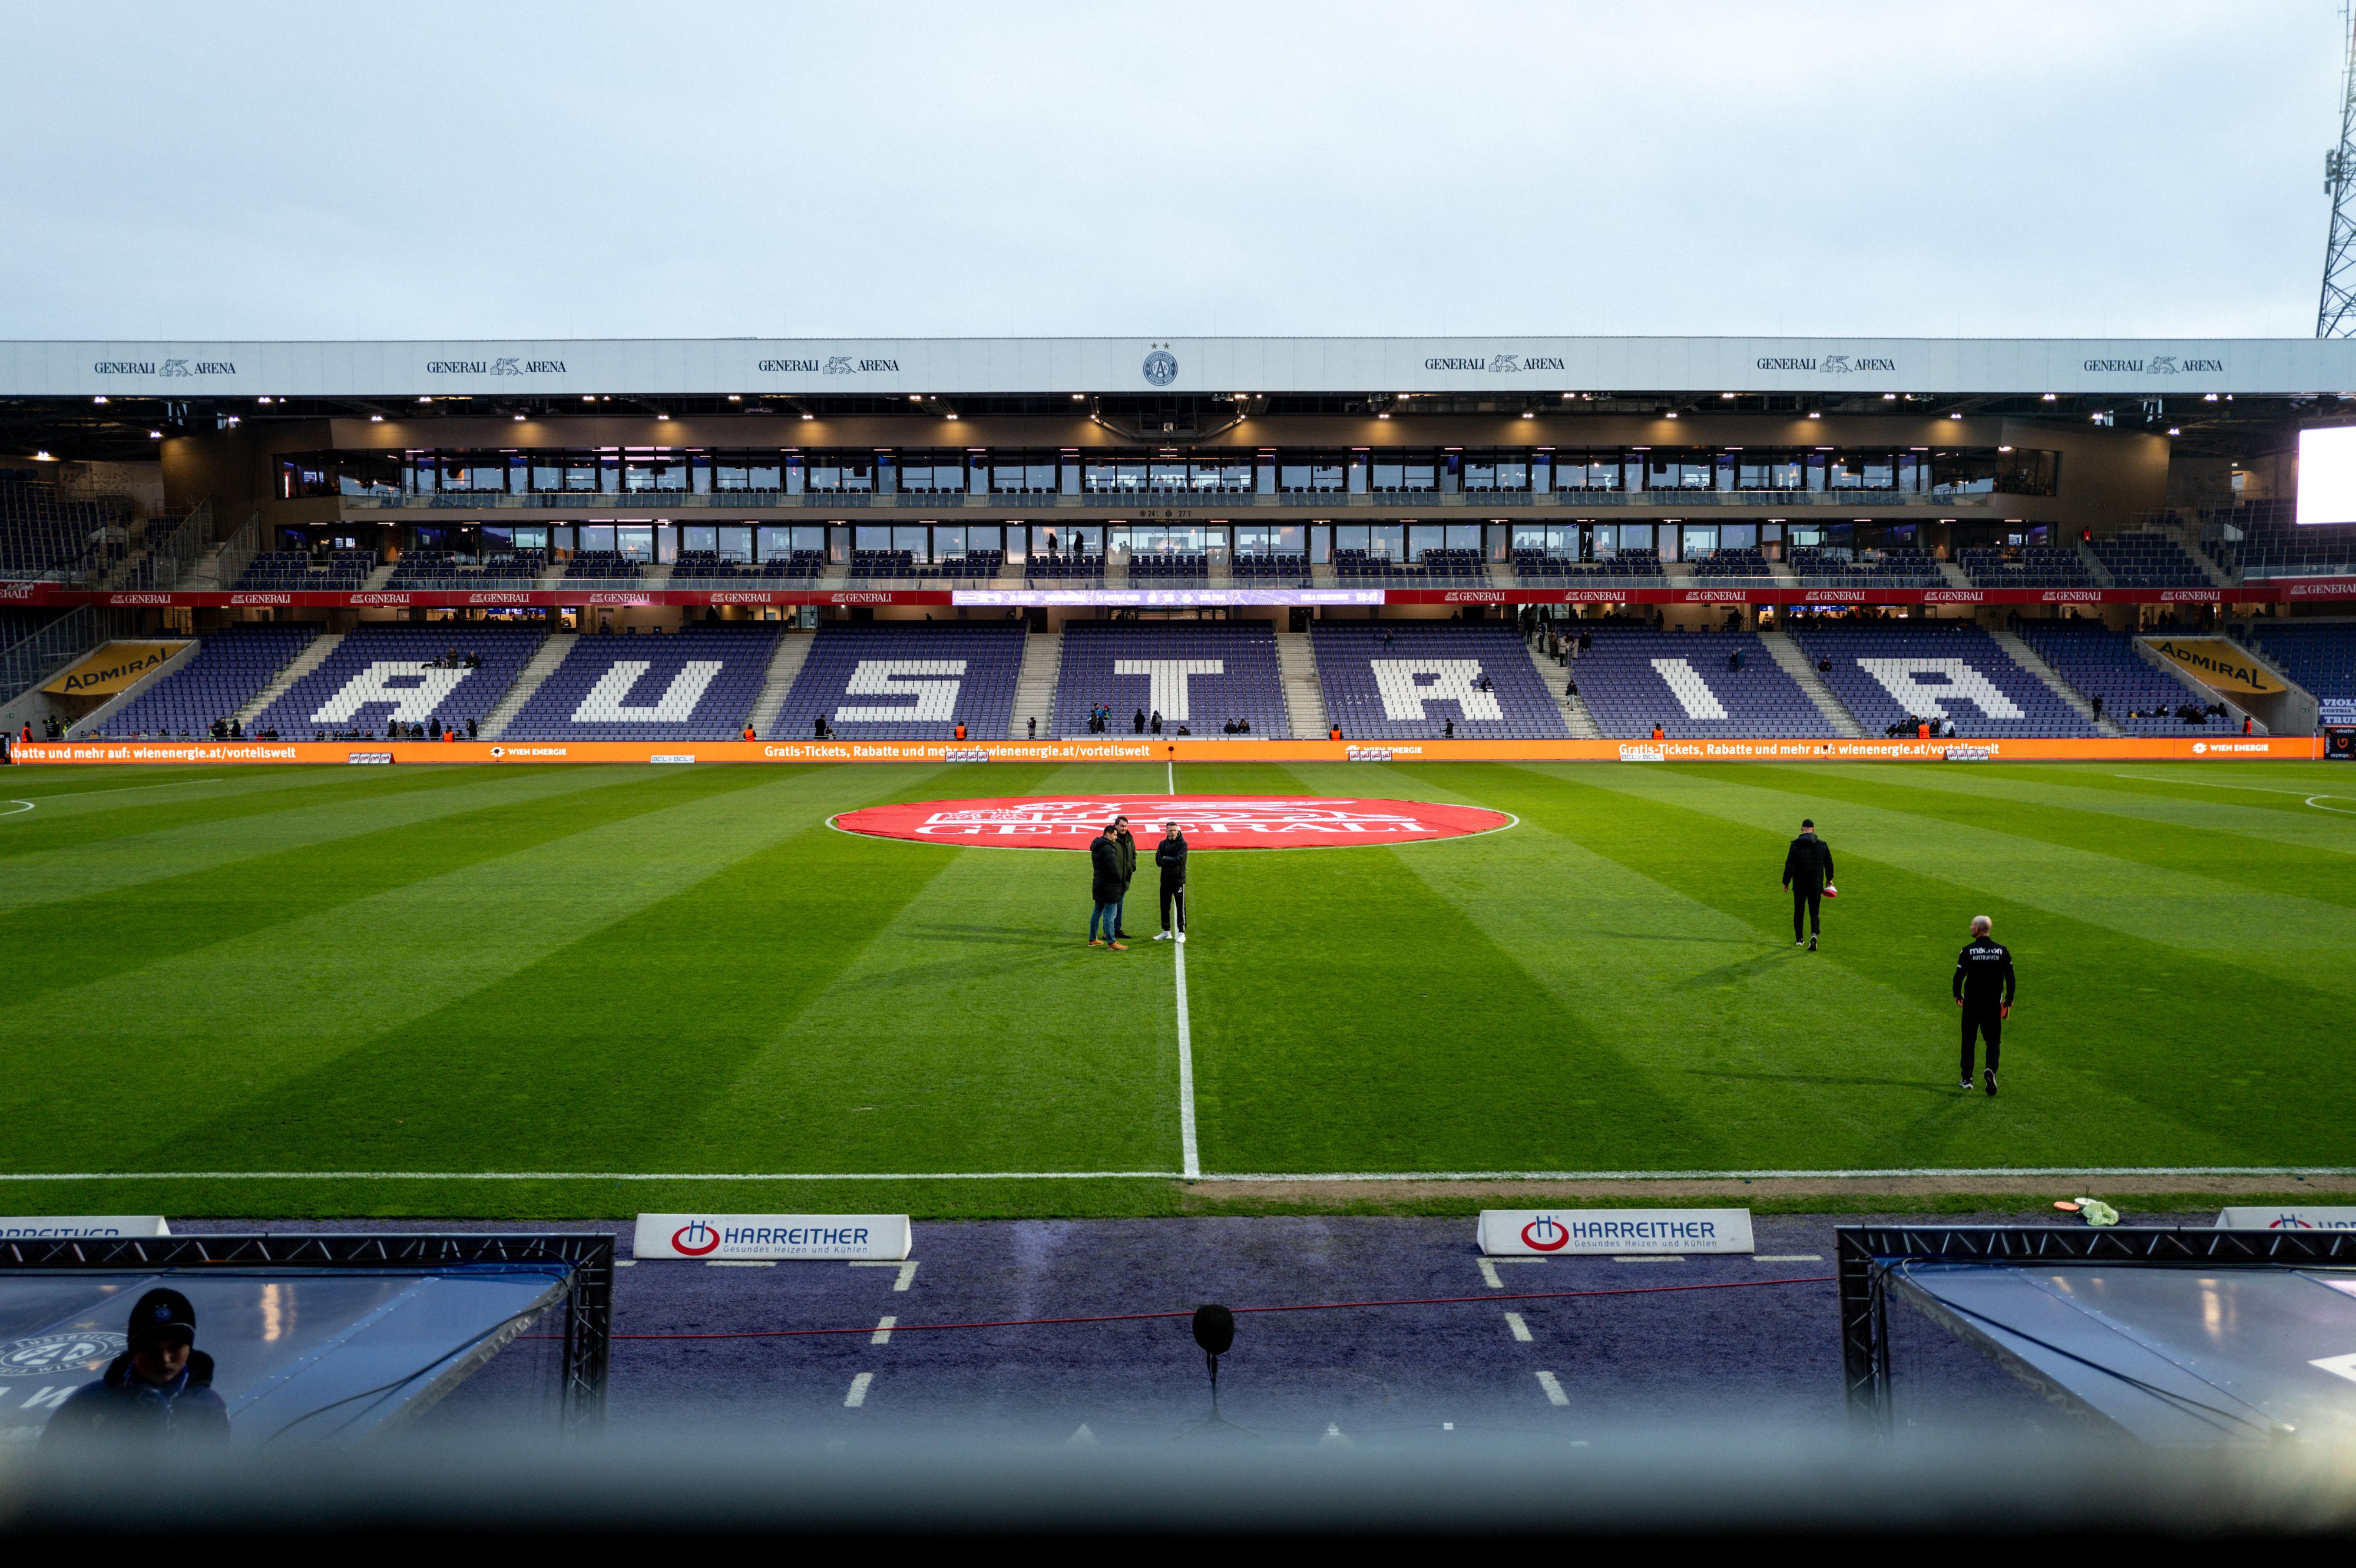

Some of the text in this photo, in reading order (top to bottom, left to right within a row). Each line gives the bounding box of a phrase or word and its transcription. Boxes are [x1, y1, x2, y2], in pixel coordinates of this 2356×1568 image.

[95, 362, 236, 374] GENERALI ARENA
[427, 361, 566, 372] GENERALI ARENA
[759, 360, 899, 372] GENERALI ARENA
[1425, 358, 1564, 370] GENERALI ARENA
[1757, 358, 1895, 370] GENERALI ARENA
[2084, 360, 2223, 371] GENERALI ARENA
[125, 594, 171, 604] GENERALI
[245, 594, 290, 604] GENERALI
[364, 594, 410, 603] GENERALI
[484, 593, 530, 603] GENERALI
[604, 593, 650, 602] GENERALI
[724, 593, 771, 602] GENERALI
[845, 593, 892, 602] GENERALI
[1460, 592, 1505, 601] GENERALI
[1579, 591, 1626, 601] GENERALI
[1700, 591, 1746, 601] GENERALI
[1820, 591, 1865, 600] GENERALI
[1938, 591, 1983, 600] GENERALI
[2056, 591, 2101, 600] GENERALI
[2175, 591, 2221, 600] GENERALI
[64, 647, 172, 692] ADMIRAL
[2158, 641, 2267, 702] ADMIRAL
[48, 747, 71, 759] und
[74, 747, 105, 759] mehr
[108, 747, 130, 759] auf:
[133, 746, 296, 760] wienenergie.at/vorteilswelt
[765, 745, 851, 758] Gratis-Tickets,
[854, 745, 899, 757] Rabatte
[902, 745, 924, 756] und
[988, 745, 1150, 759] wienenergie.at/vorteilswelt
[1619, 744, 1703, 756] Gratis-Tickets,
[1707, 743, 1752, 755] Rabatte
[1755, 743, 1777, 755] und
[1780, 743, 1811, 755] mehr
[1814, 743, 1836, 755] auf:
[1573, 1222, 1716, 1238] HARREITHER
[724, 1228, 869, 1245] HARREITHER
[1684, 1239, 1717, 1247] Kühlen
[834, 1245, 868, 1253] Kühlen
[38, 1360, 88, 1373] WIEN
